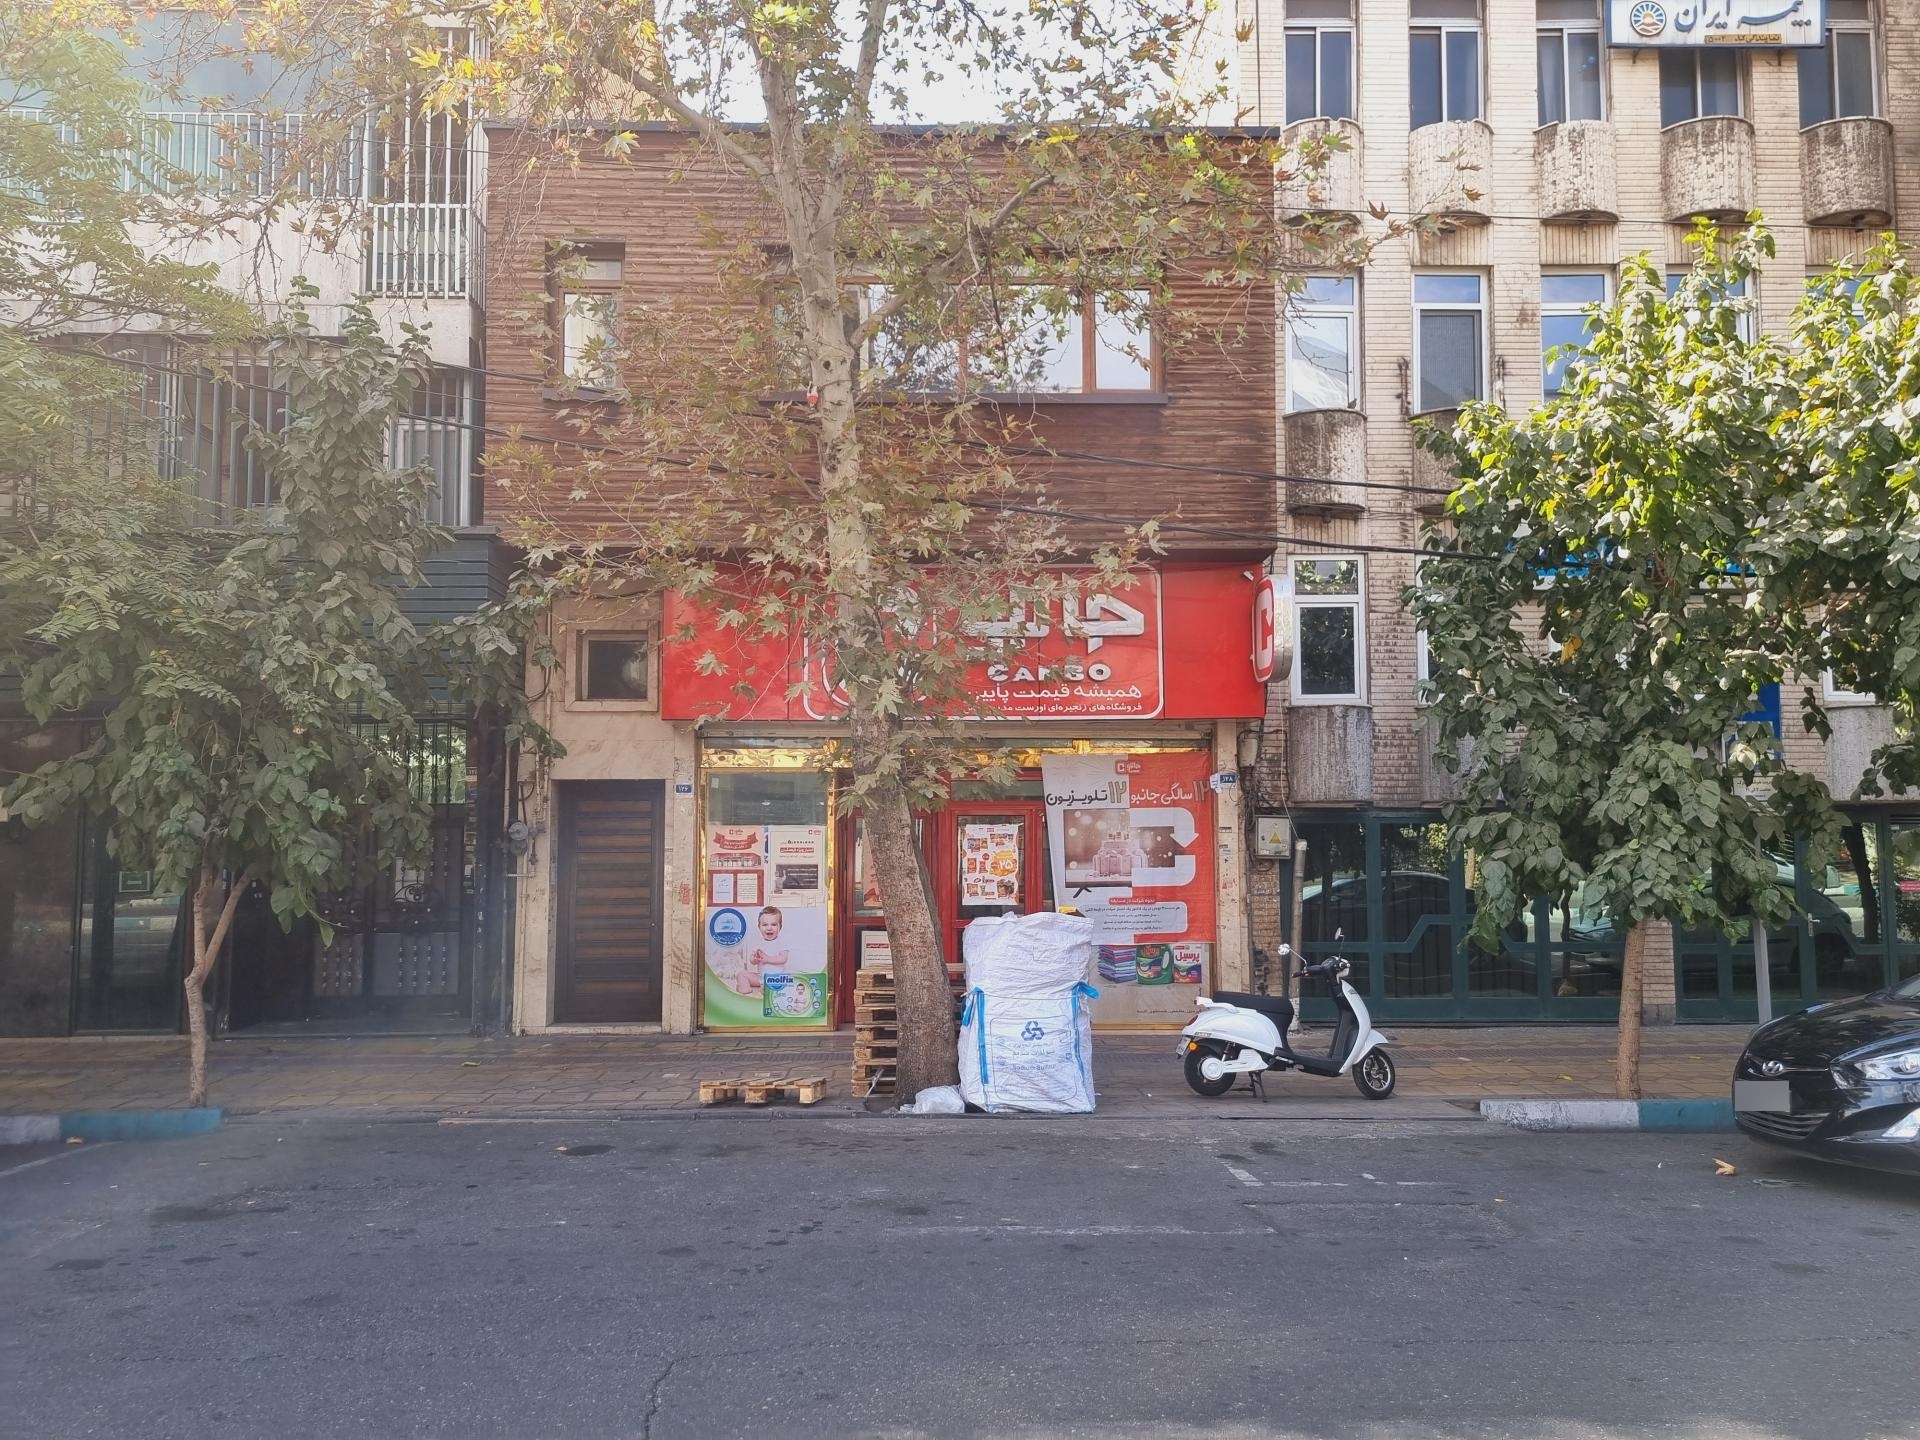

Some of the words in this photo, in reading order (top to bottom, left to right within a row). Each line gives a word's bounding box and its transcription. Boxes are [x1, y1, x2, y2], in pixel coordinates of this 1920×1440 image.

[1013, 684, 1070, 701] قیمت
[1074, 684, 1142, 701] همیشه
[1015, 703, 1046, 712] اورست
[1046, 790, 1107, 806] تلویزیون
[1108, 781, 1126, 803] ۱۲
[1131, 788, 1160, 804] جانبو
[1160, 782, 1192, 804] سالگی
[1175, 952, 1200, 963] پرسیل
